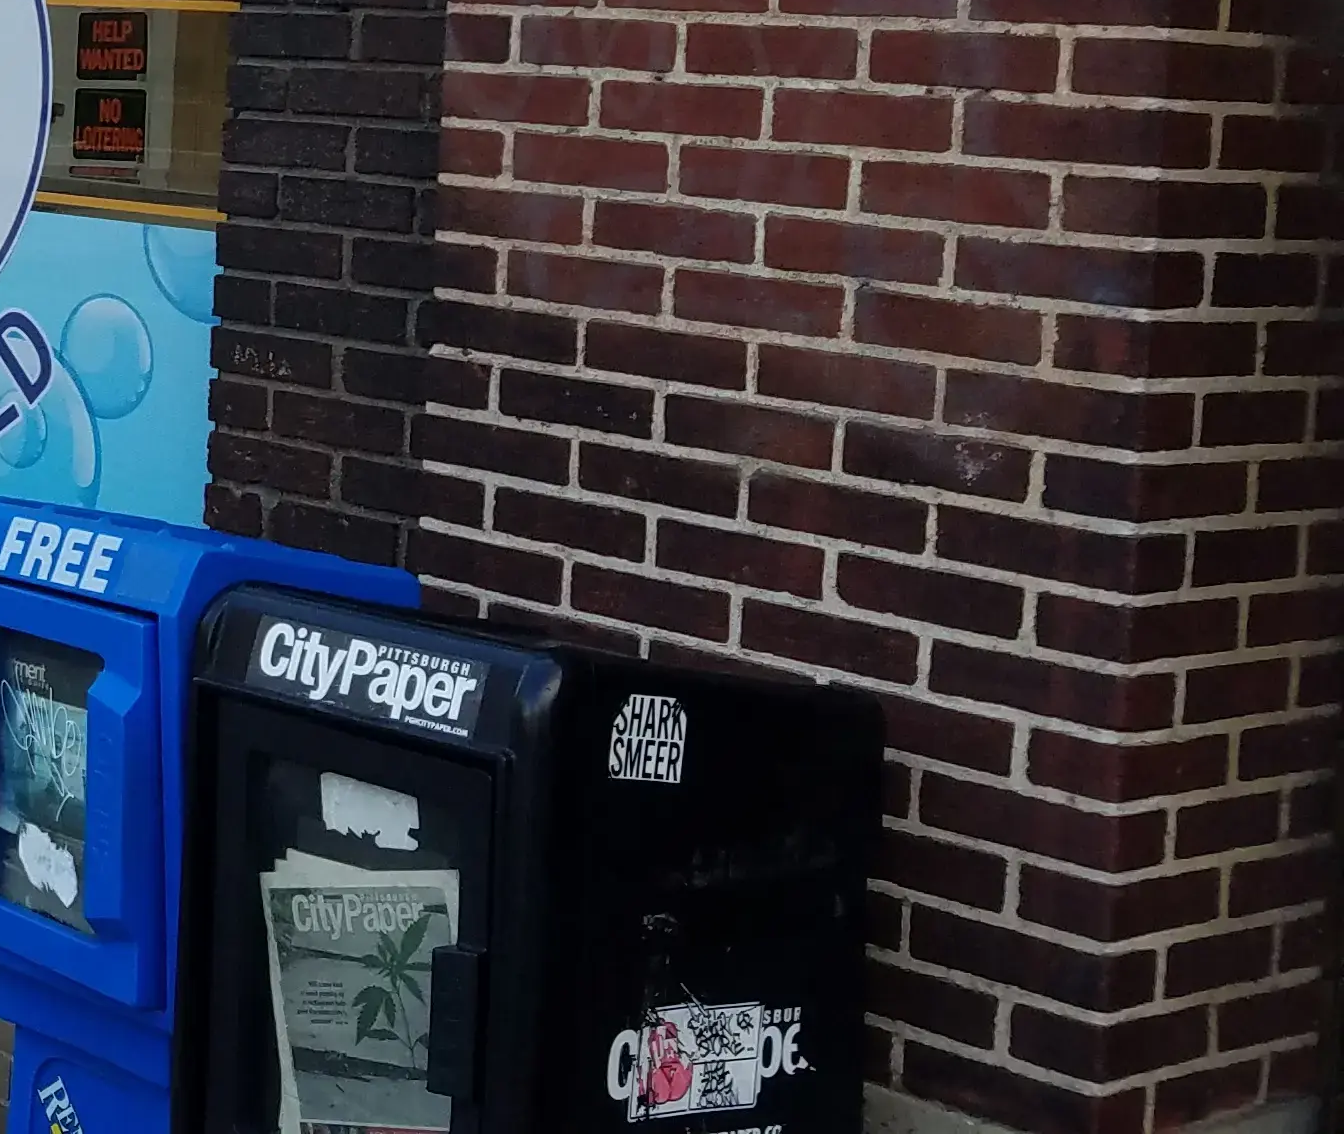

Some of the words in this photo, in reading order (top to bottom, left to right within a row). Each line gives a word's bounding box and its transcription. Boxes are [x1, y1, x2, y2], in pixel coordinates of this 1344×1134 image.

[92, 20, 132, 42] HELP
[79, 47, 145, 71] WANTED
[99, 97, 122, 124] NO
[260, 622, 478, 721] CityPaper
[377, 645, 470, 677] PITTSBURGH
[613, 697, 683, 741] SHARK
[611, 737, 681, 782] SMEER
[37, 1075, 84, 1134] RE
